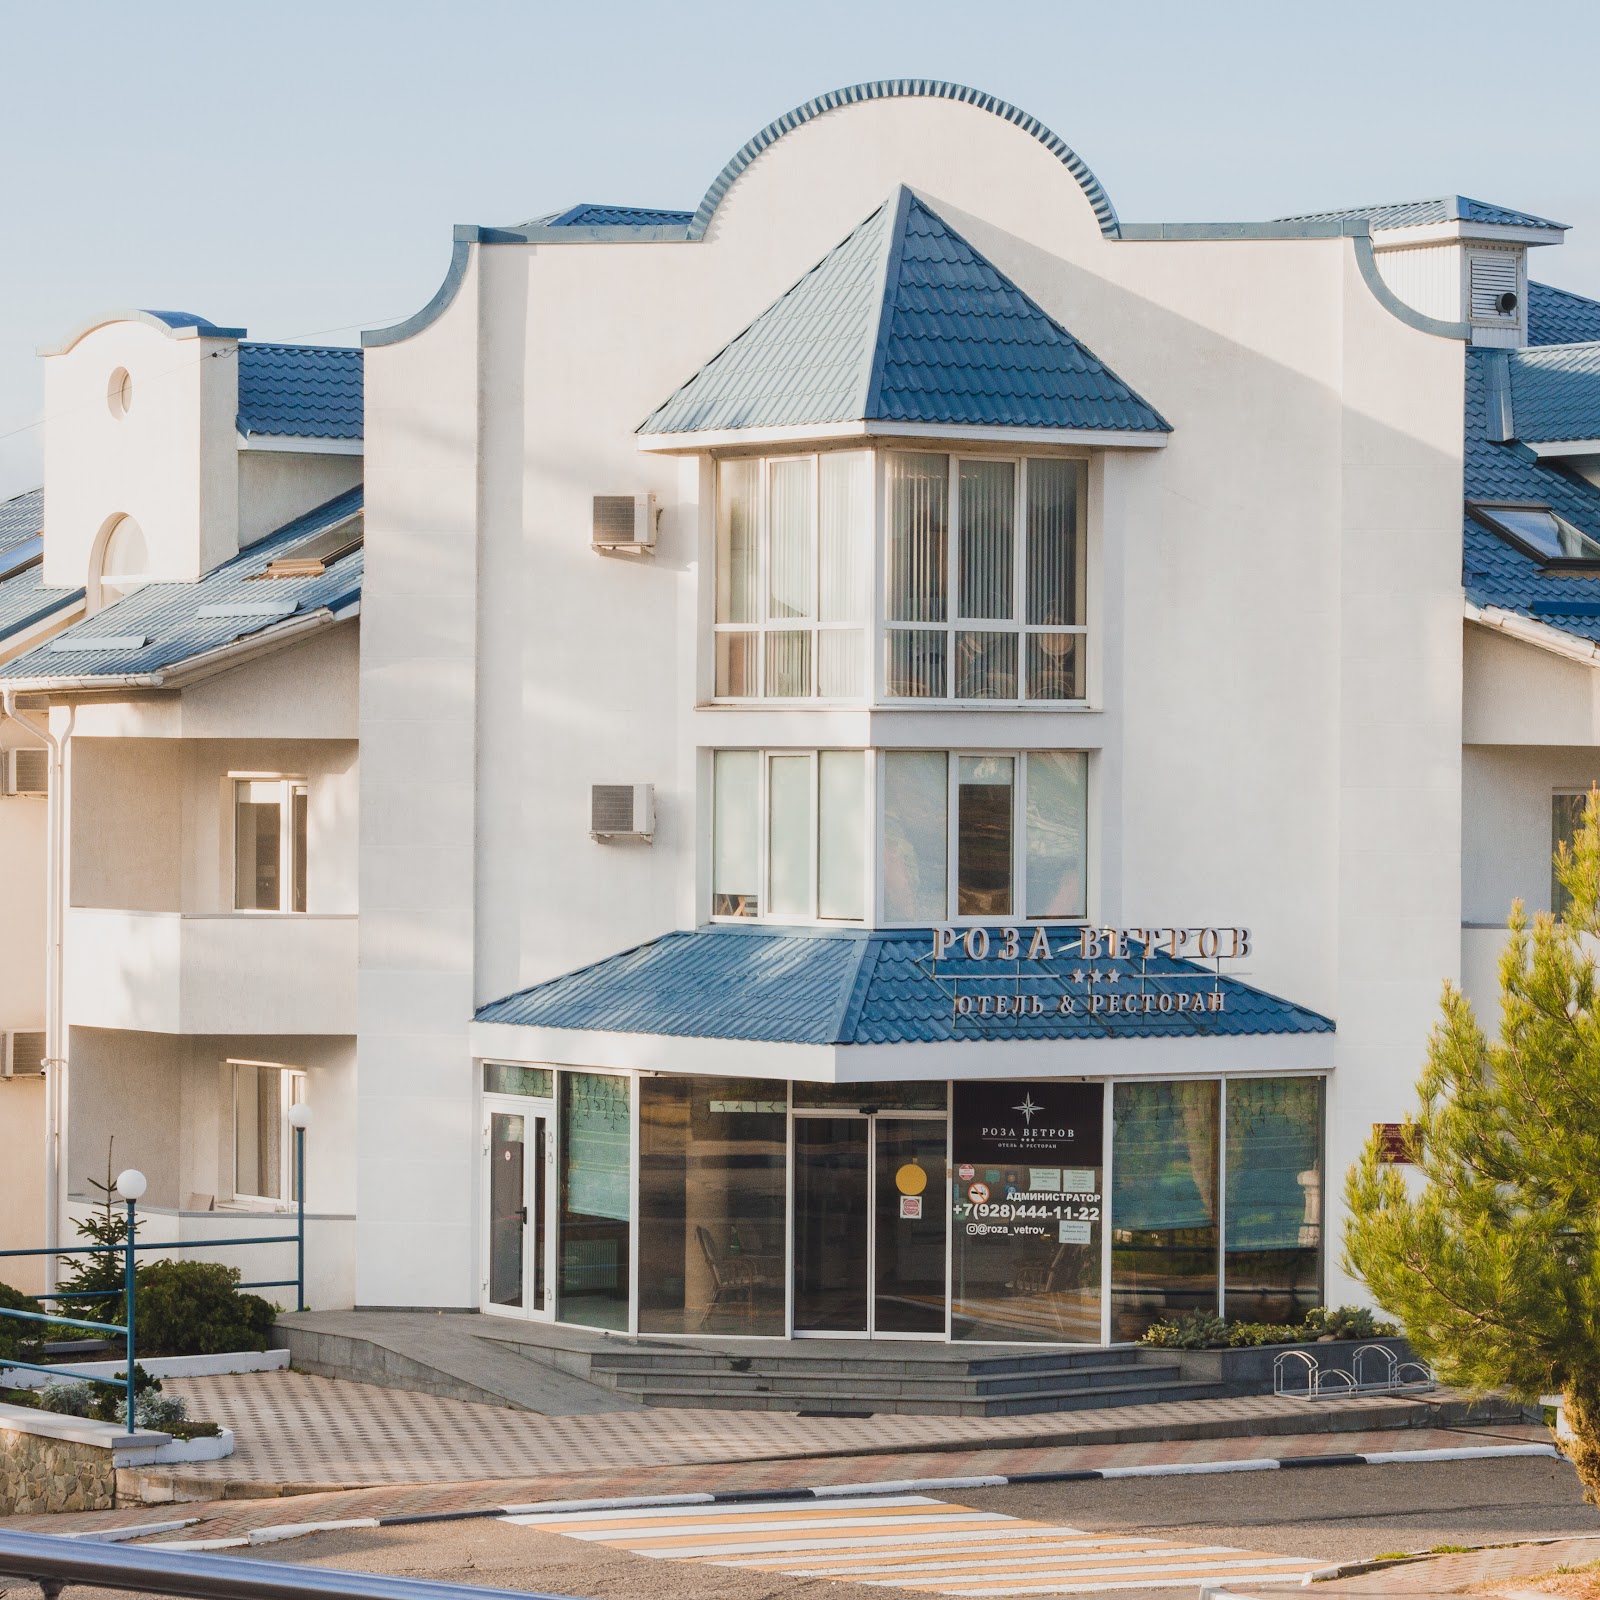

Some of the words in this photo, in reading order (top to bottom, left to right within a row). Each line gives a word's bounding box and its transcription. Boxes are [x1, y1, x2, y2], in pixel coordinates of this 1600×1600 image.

[933, 927, 1054, 960] РОЗА
[1080, 927, 1253, 960] ВЕТРОВ
[955, 995, 1045, 1015] ОТЕЛЬ
[1058, 995, 1076, 1014] &
[1091, 993, 1226, 1014] РЕСТОРАН
[982, 1128, 1016, 1136] РОЗА
[1023, 1128, 1075, 1137] ВЕТРОВ
[1006, 1192, 1101, 1203] АДМИНИСТРАТОР
[953, 1203, 1100, 1221] +7(928)444-11-22
